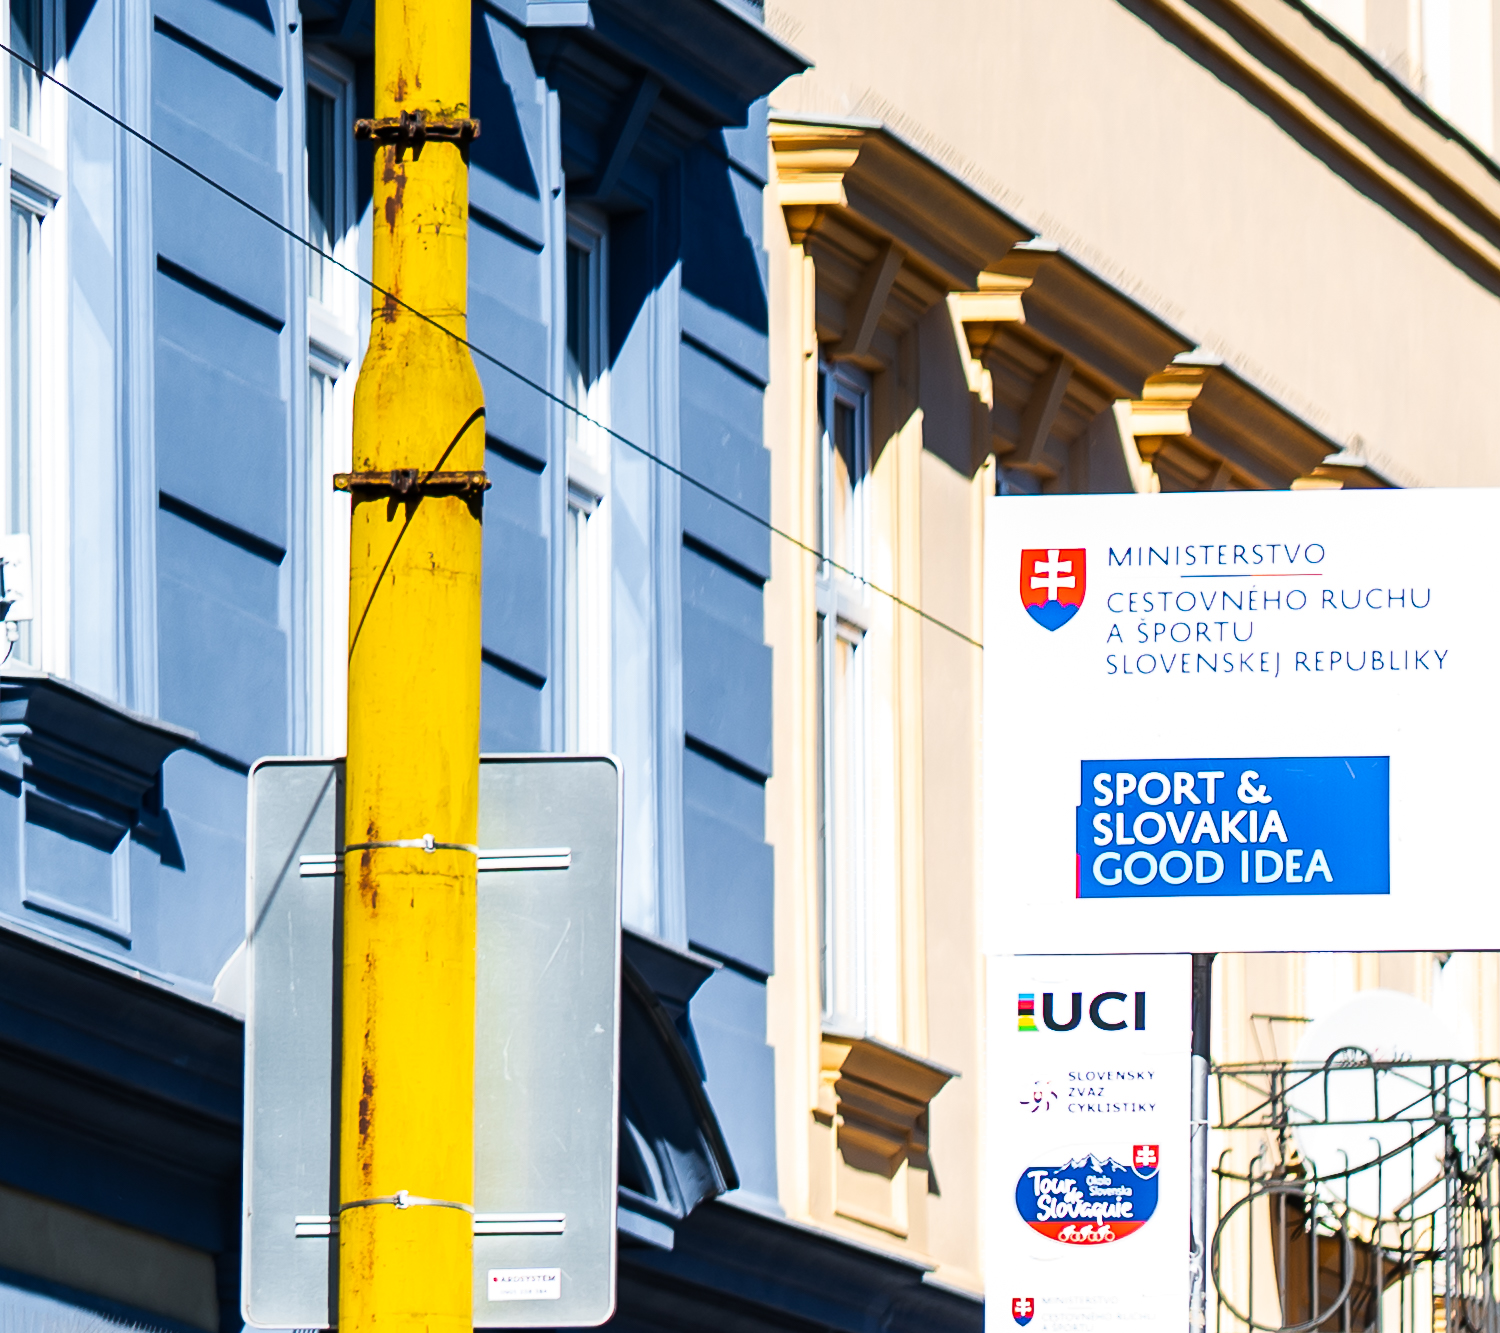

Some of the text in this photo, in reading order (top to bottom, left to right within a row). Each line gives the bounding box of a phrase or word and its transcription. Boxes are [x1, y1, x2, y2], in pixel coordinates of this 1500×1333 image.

[1108, 543, 1325, 567] MINISTERSTVO
[1107, 583, 1431, 612] CESTOVNÉHO RUCHU
[1106, 617, 1253, 644] A ŠPORTU
[1106, 649, 1449, 678] SLOVENSKEJ REPUBLIKY
[1093, 771, 1273, 807] SPORT &
[1092, 810, 1288, 845] SLOVAKIA
[1093, 849, 1333, 886] GOOD IDEA
[1042, 991, 1146, 1032] UCI
[1067, 1102, 1156, 1114] CYKLISTIKY
[1027, 1170, 1076, 1196] Tour
[1036, 1194, 1134, 1226] Slovaquie
